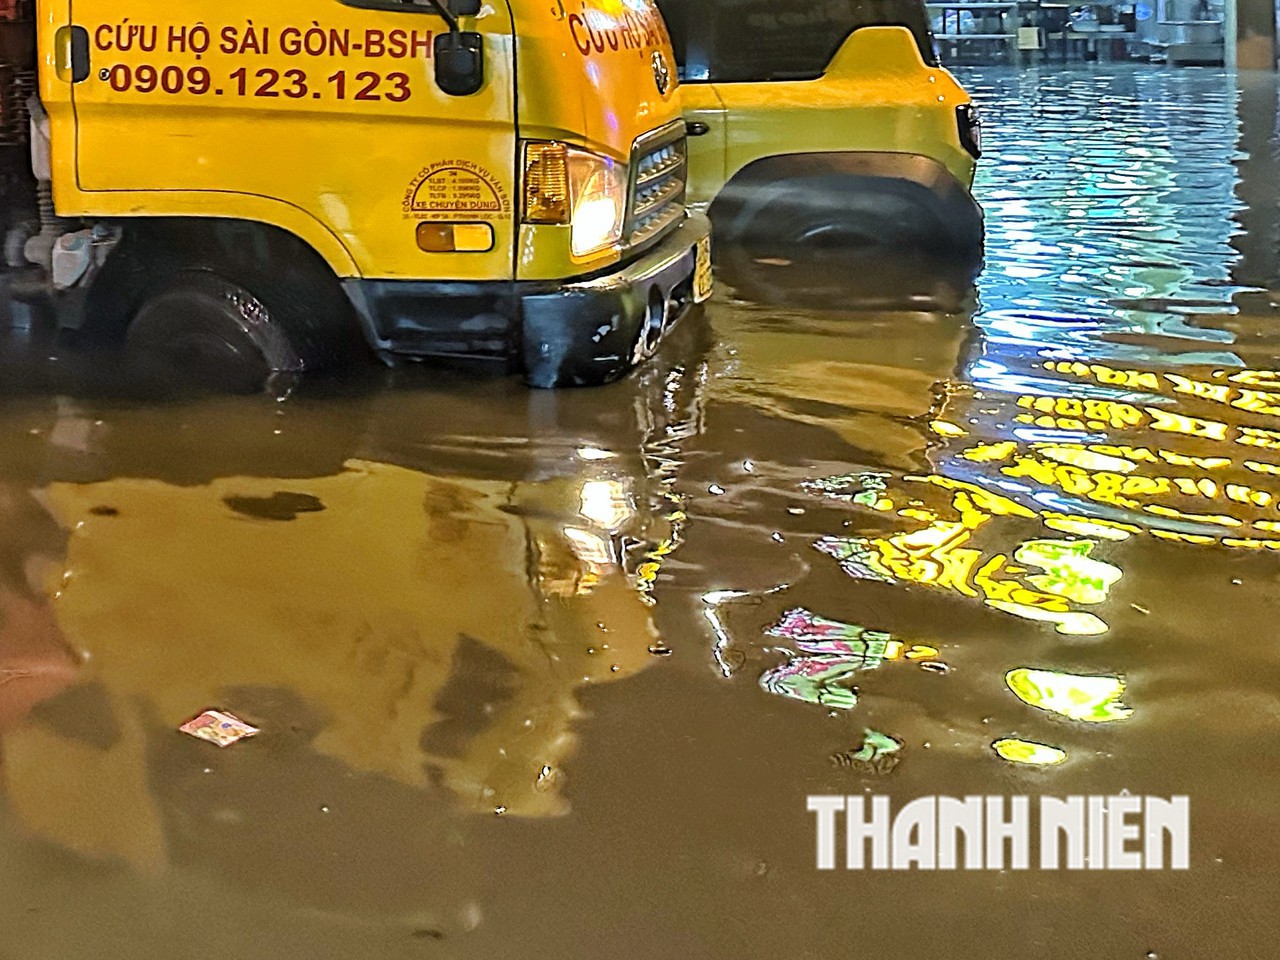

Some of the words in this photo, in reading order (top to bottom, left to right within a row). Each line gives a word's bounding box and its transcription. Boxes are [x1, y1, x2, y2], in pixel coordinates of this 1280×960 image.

[95, 18, 157, 52] CỨU
[168, 22, 210, 60] HỘ
[220, 19, 269, 55] SÀI
[109, 64, 412, 103] 0909.123.123
